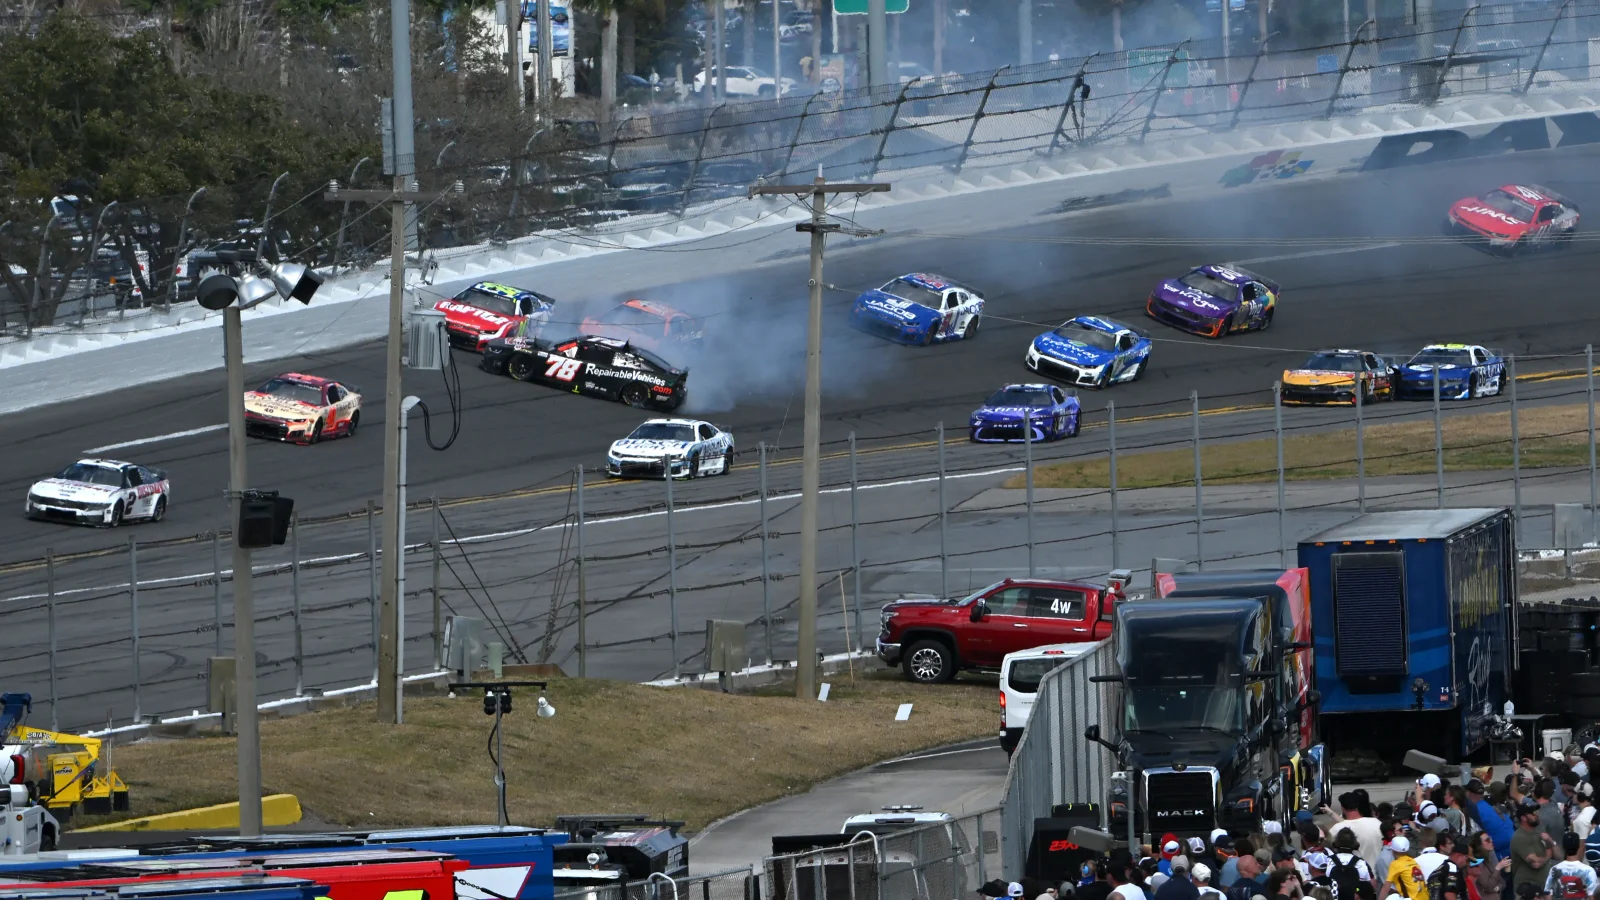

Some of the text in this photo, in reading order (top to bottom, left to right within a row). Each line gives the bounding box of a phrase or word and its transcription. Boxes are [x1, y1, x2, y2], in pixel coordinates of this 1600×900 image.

[864, 299, 917, 320] JACOB
[1041, 337, 1100, 359] Freeway
[544, 353, 583, 382] 78
[585, 362, 667, 386] RepairableVehicles
[650, 385, 673, 395] .com
[124, 490, 137, 516] 2
[1050, 599, 1071, 614] 4W
[1157, 809, 1205, 817] MACK
